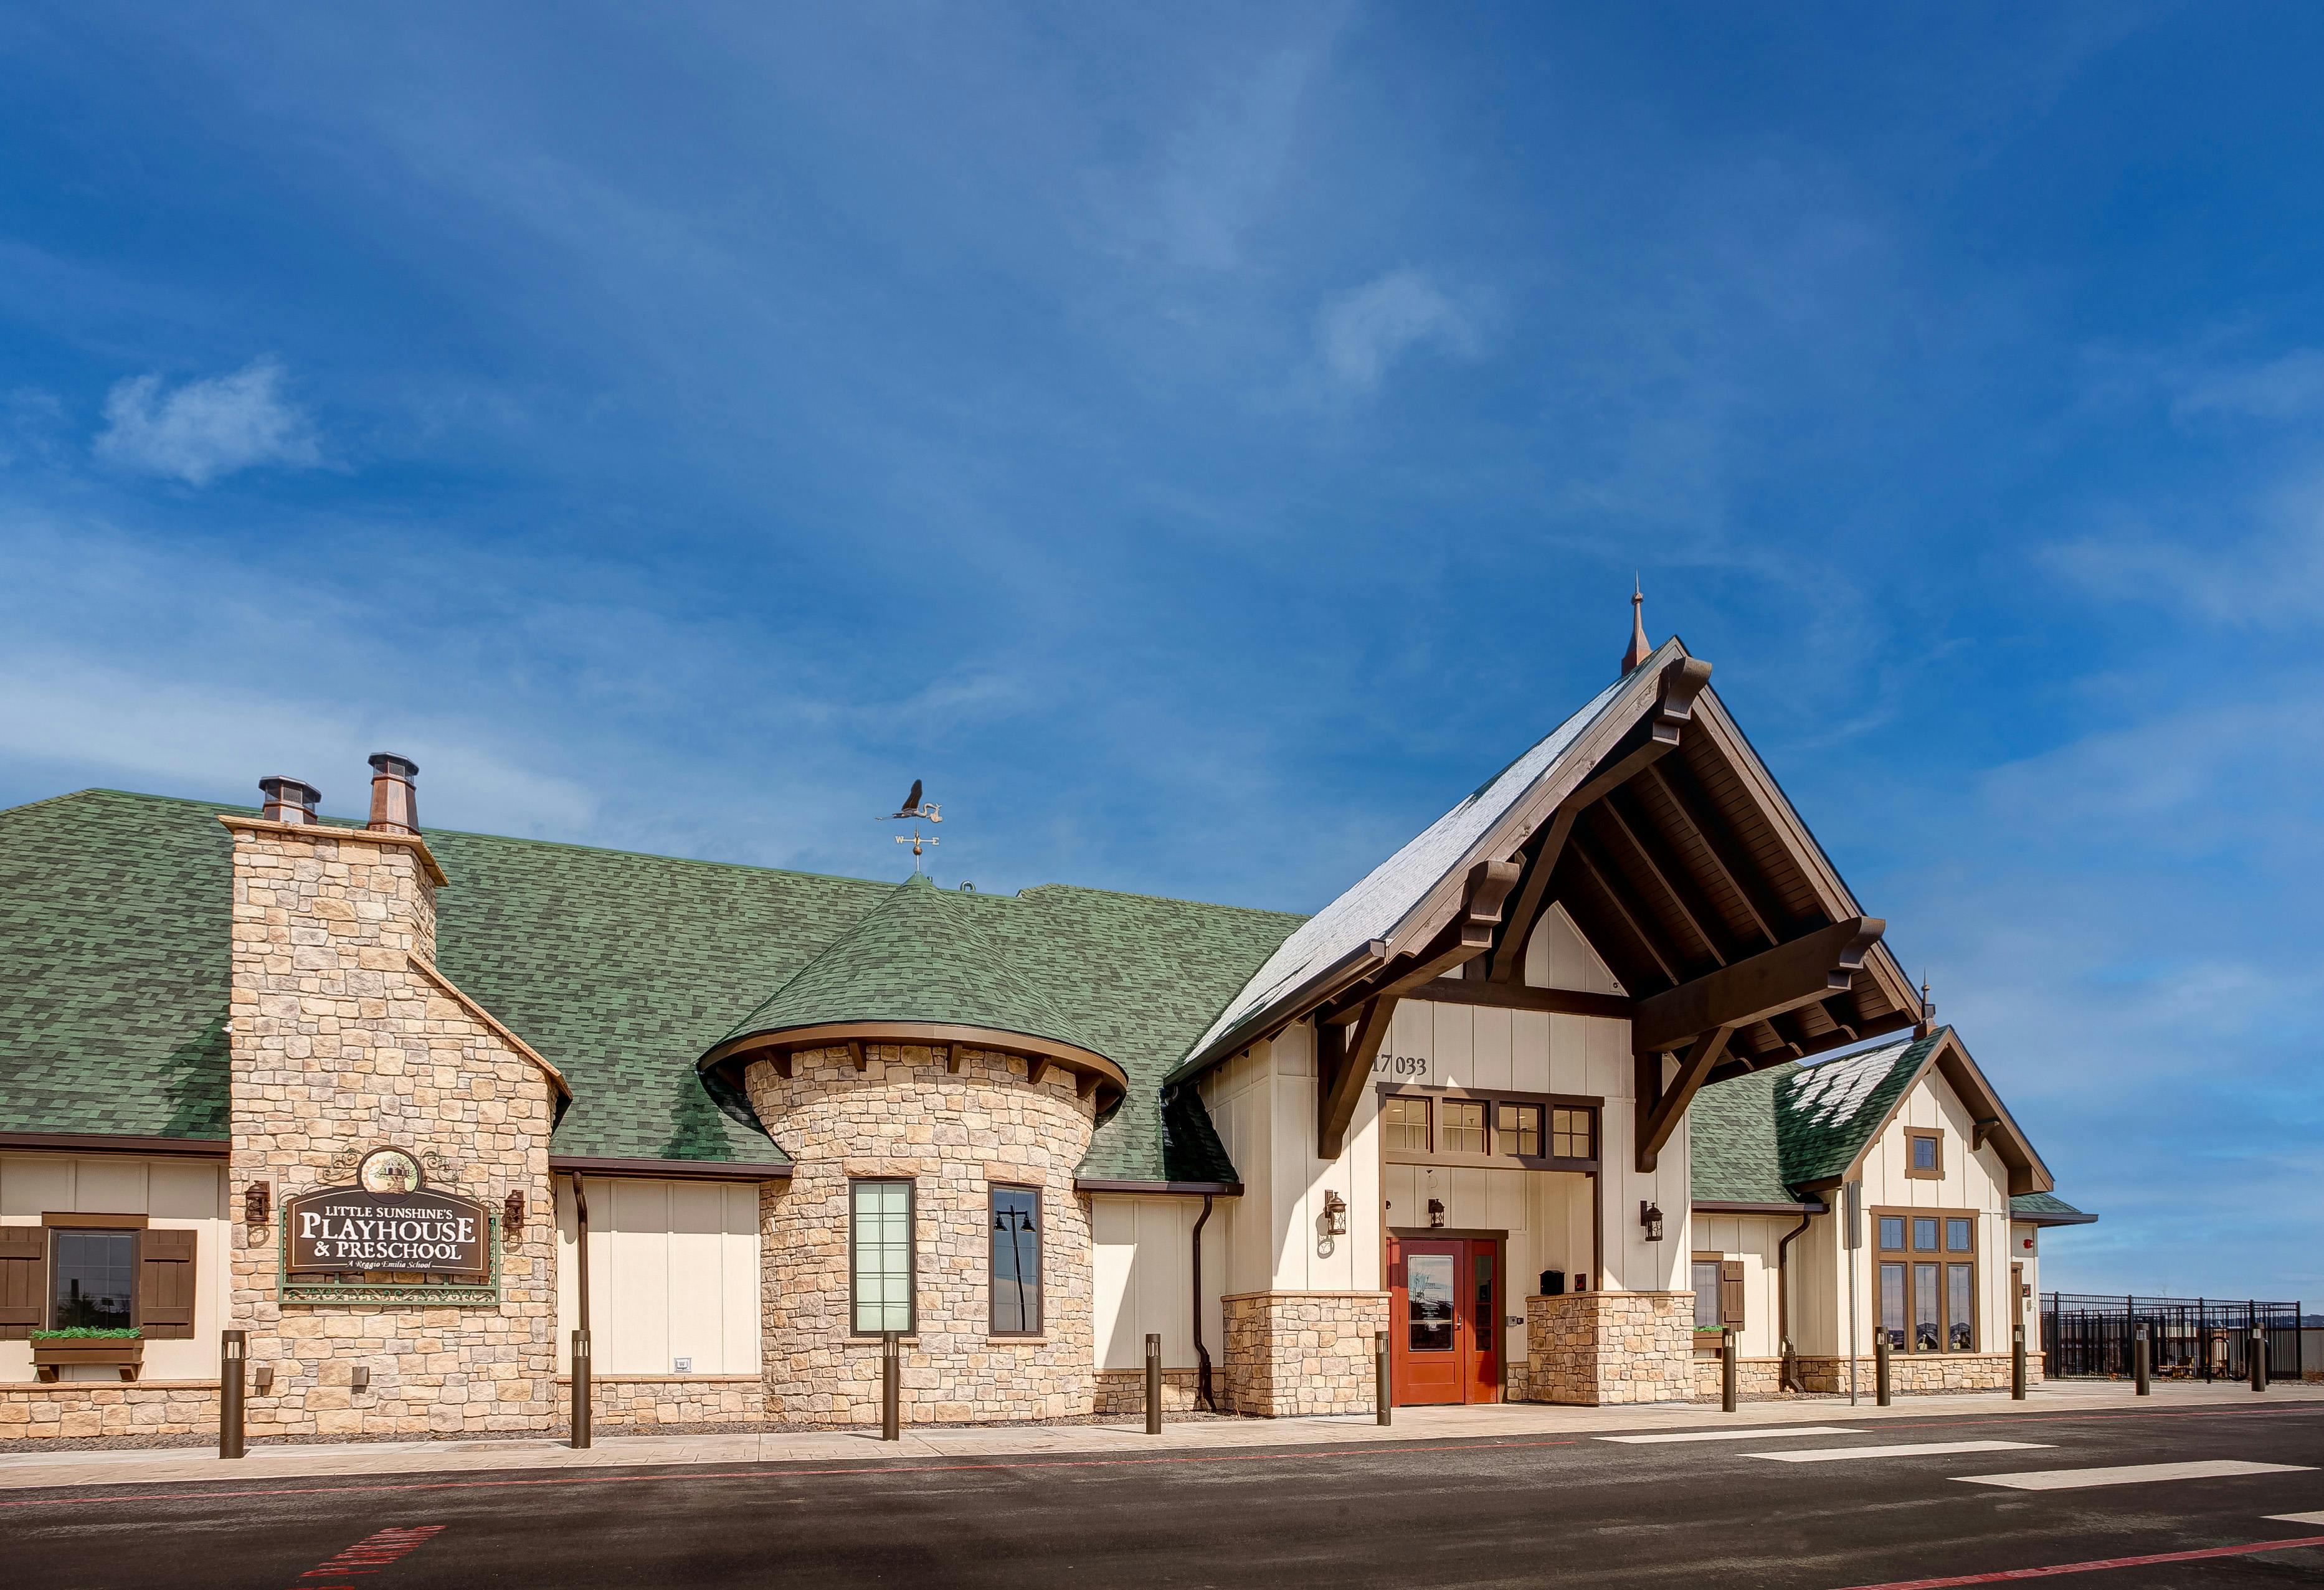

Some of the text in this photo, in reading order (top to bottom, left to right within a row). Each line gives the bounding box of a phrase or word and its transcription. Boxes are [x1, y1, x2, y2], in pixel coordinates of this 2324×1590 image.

[895, 836, 904, 844] W
[932, 837, 939, 845] E
[325, 1205, 453, 1220] LITTLE SUNSHINE'S
[299, 1212, 476, 1243] PLAYHOUSE
[313, 1241, 462, 1260] & PRESCHOOL
[355, 1260, 381, 1270] Reggio
[381, 1260, 406, 1268] Emilia
[407, 1260, 433, 1269] School
[298, 1525, 448, 1578] PARKING
